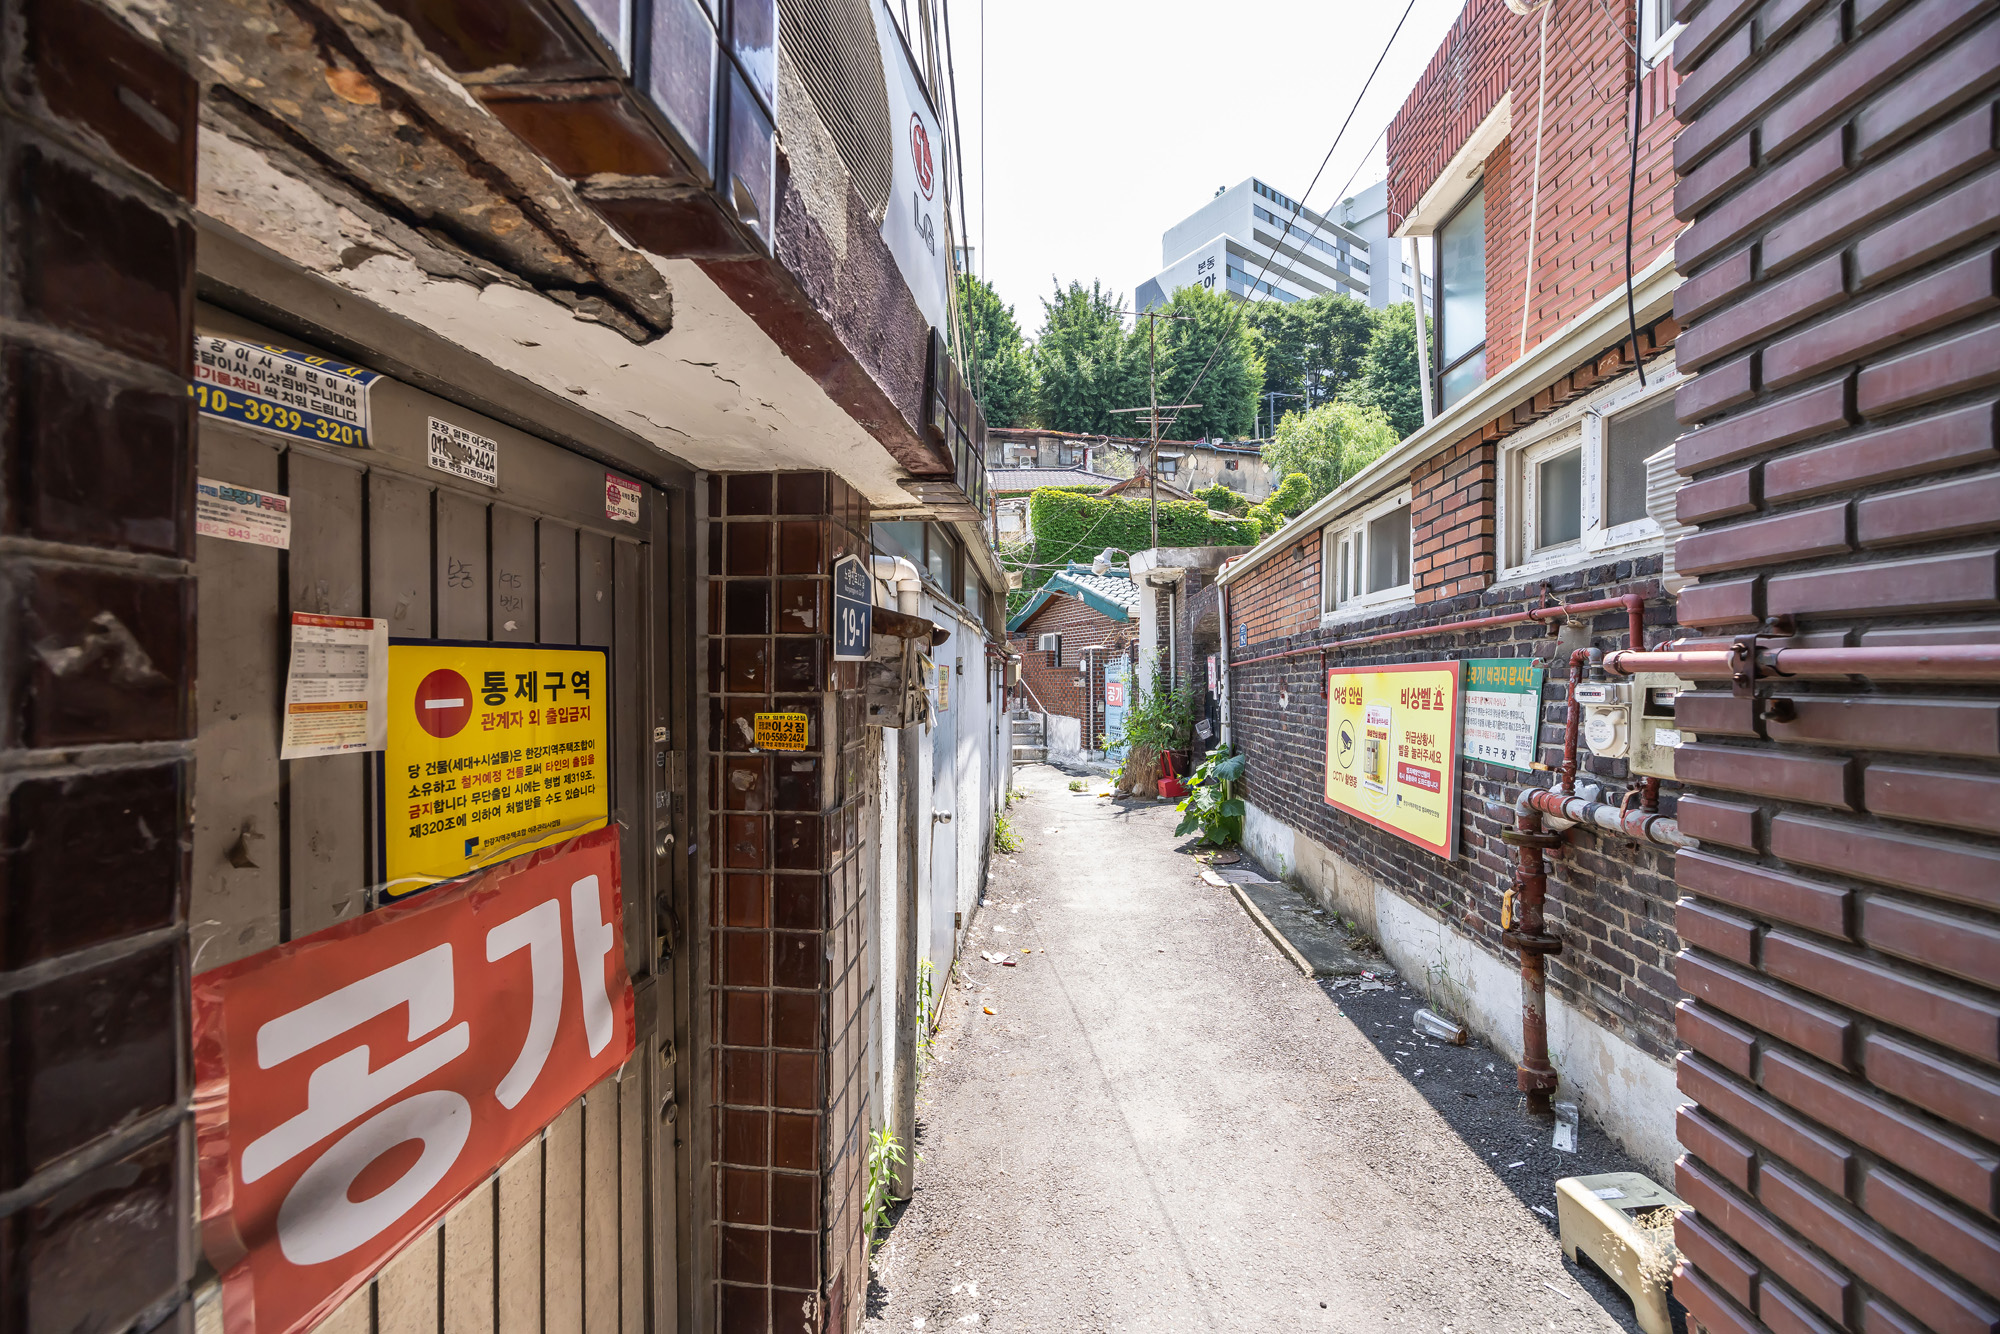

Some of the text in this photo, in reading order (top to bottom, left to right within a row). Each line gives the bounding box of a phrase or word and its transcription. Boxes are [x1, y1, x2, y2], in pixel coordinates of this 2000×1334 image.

[914, 191, 935, 256] LG
[1198, 255, 1215, 275] 본동
[194, 365, 261, 395] 기물처리
[311, 400, 358, 422] 드립니다
[842, 607, 866, 647] 19-1
[480, 669, 591, 706] 통제구역
[1487, 666, 1508, 686] 버리지
[1509, 666, 1534, 687] 맙시다
[1107, 685, 1123, 702] 공가
[1334, 686, 1363, 706] 여성 안심
[1400, 687, 1431, 710] 비상벨
[480, 705, 591, 731] 관계자 외 출입금지
[772, 721, 805, 733] 이삿짐
[1405, 730, 1435, 748] 위급상황시
[408, 738, 596, 779] 당 건물(세대+시설물)은 한강지역주택조합이
[1398, 744, 1442, 764] 벨을 눌러주세요
[1479, 745, 1517, 761] 동작구청장
[408, 753, 595, 799] 소유하고 철거예정 건물로써 타인의 출입을
[1333, 770, 1344, 783] CCTV
[1345, 773, 1358, 789] 촬영중
[408, 794, 467, 820] 금지합니다
[471, 786, 511, 806] 무단출입
[515, 780, 541, 795] 시에는
[544, 775, 561, 790] 형법
[409, 783, 596, 839] 제320조에 의하여 처벌받을 수도 있습니다
[484, 828, 527, 848] 한강지역주택조합
[241, 874, 614, 1266] 공가
